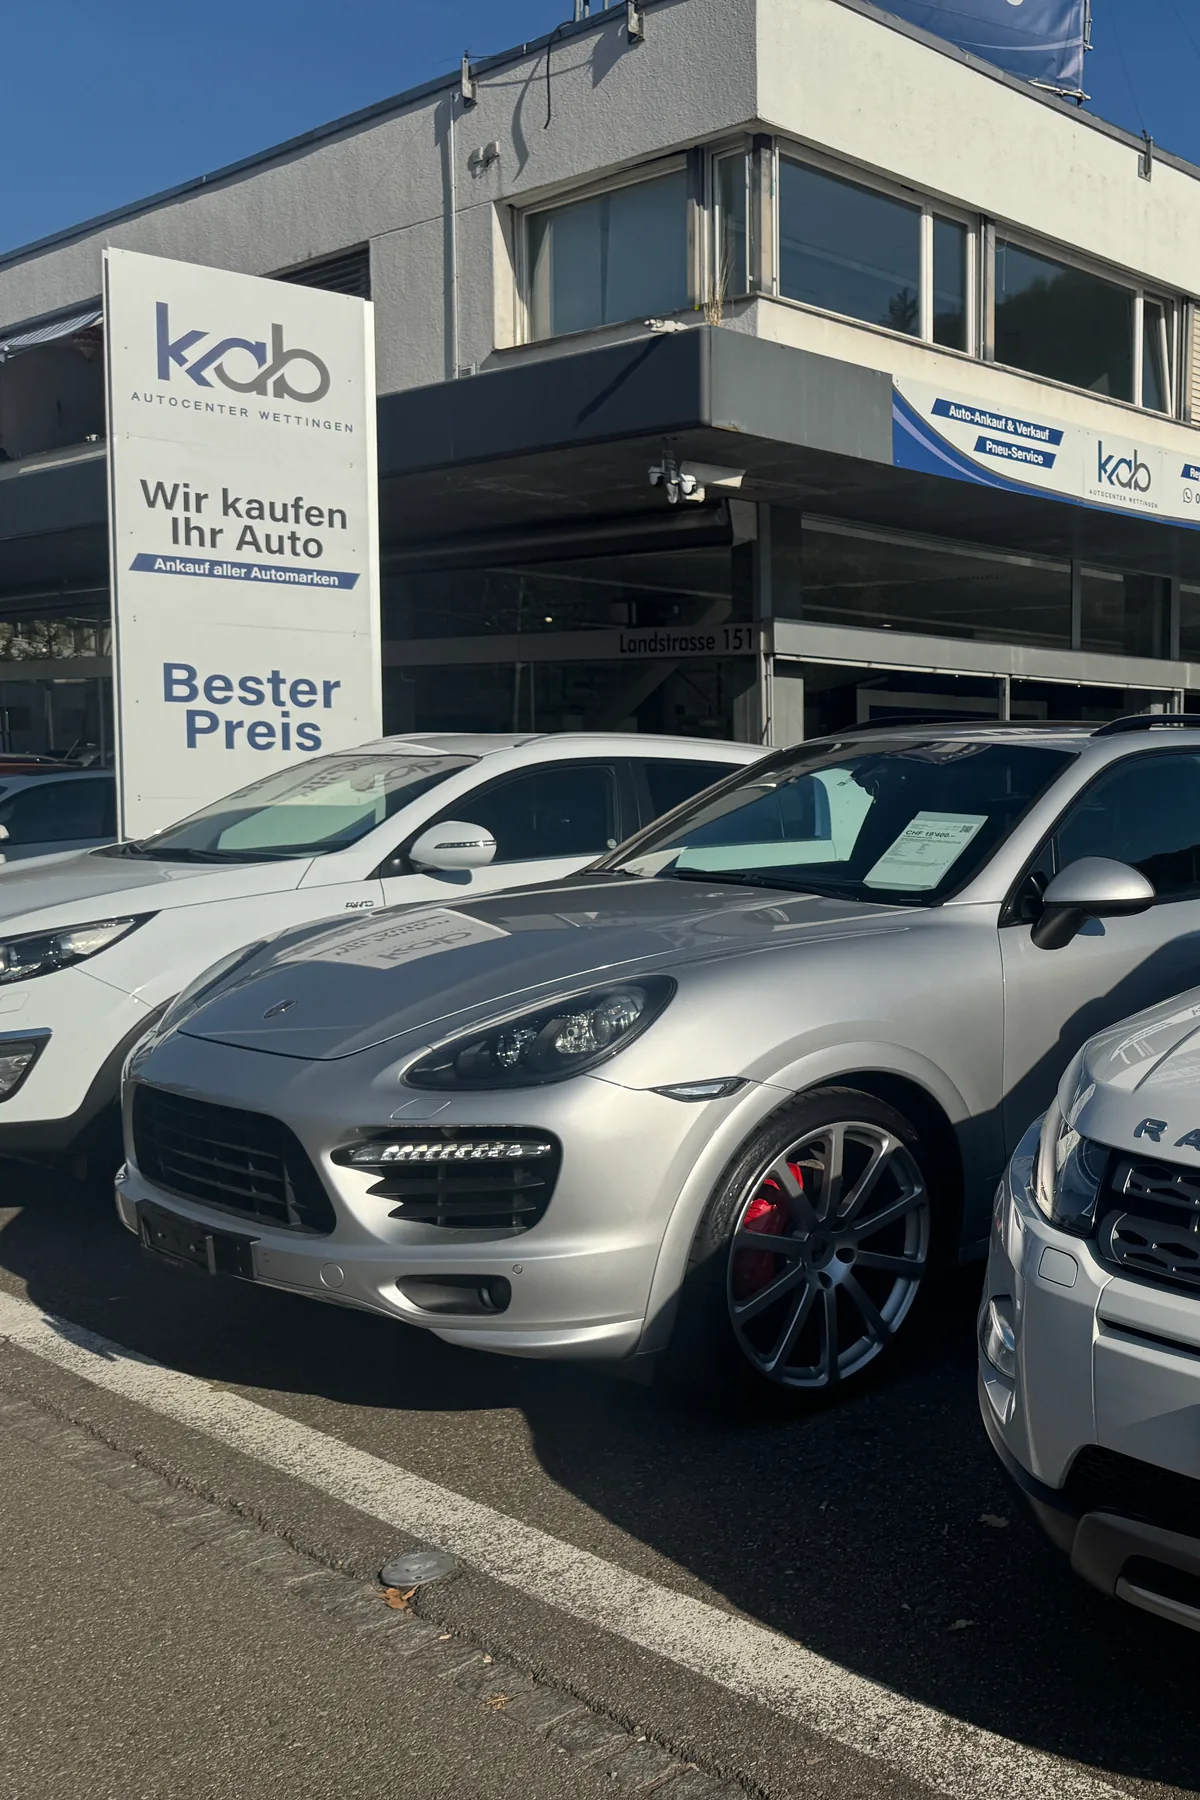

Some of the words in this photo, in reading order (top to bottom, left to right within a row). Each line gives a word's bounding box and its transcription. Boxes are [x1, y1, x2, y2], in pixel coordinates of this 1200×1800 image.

[156, 301, 331, 403] kab
[131, 391, 249, 418] AUTOCENTER
[258, 410, 355, 433] WETTINGEN
[949, 405, 1006, 430] Auto-Ankauf
[1007, 421, 1014, 432] &
[1016, 422, 1050, 440] Verkauf
[985, 440, 1044, 464] Pneu-Service
[1098, 440, 1151, 493] kab
[139, 479, 209, 514] Wir
[221, 487, 348, 530] kaufen
[1089, 489, 1126, 501] AUTOCENTER
[1128, 496, 1159, 509] WETTINGEN
[171, 517, 224, 548] Ihr
[236, 525, 324, 559] Auto
[154, 558, 211, 575] Ankauf
[213, 563, 248, 578] aller
[250, 566, 339, 586] Automarken
[620, 631, 716, 653] Landstrasse
[723, 628, 753, 650] 151
[163, 662, 341, 709] Bester
[186, 709, 322, 752] Preis
[345, 900, 374, 908] AWD
